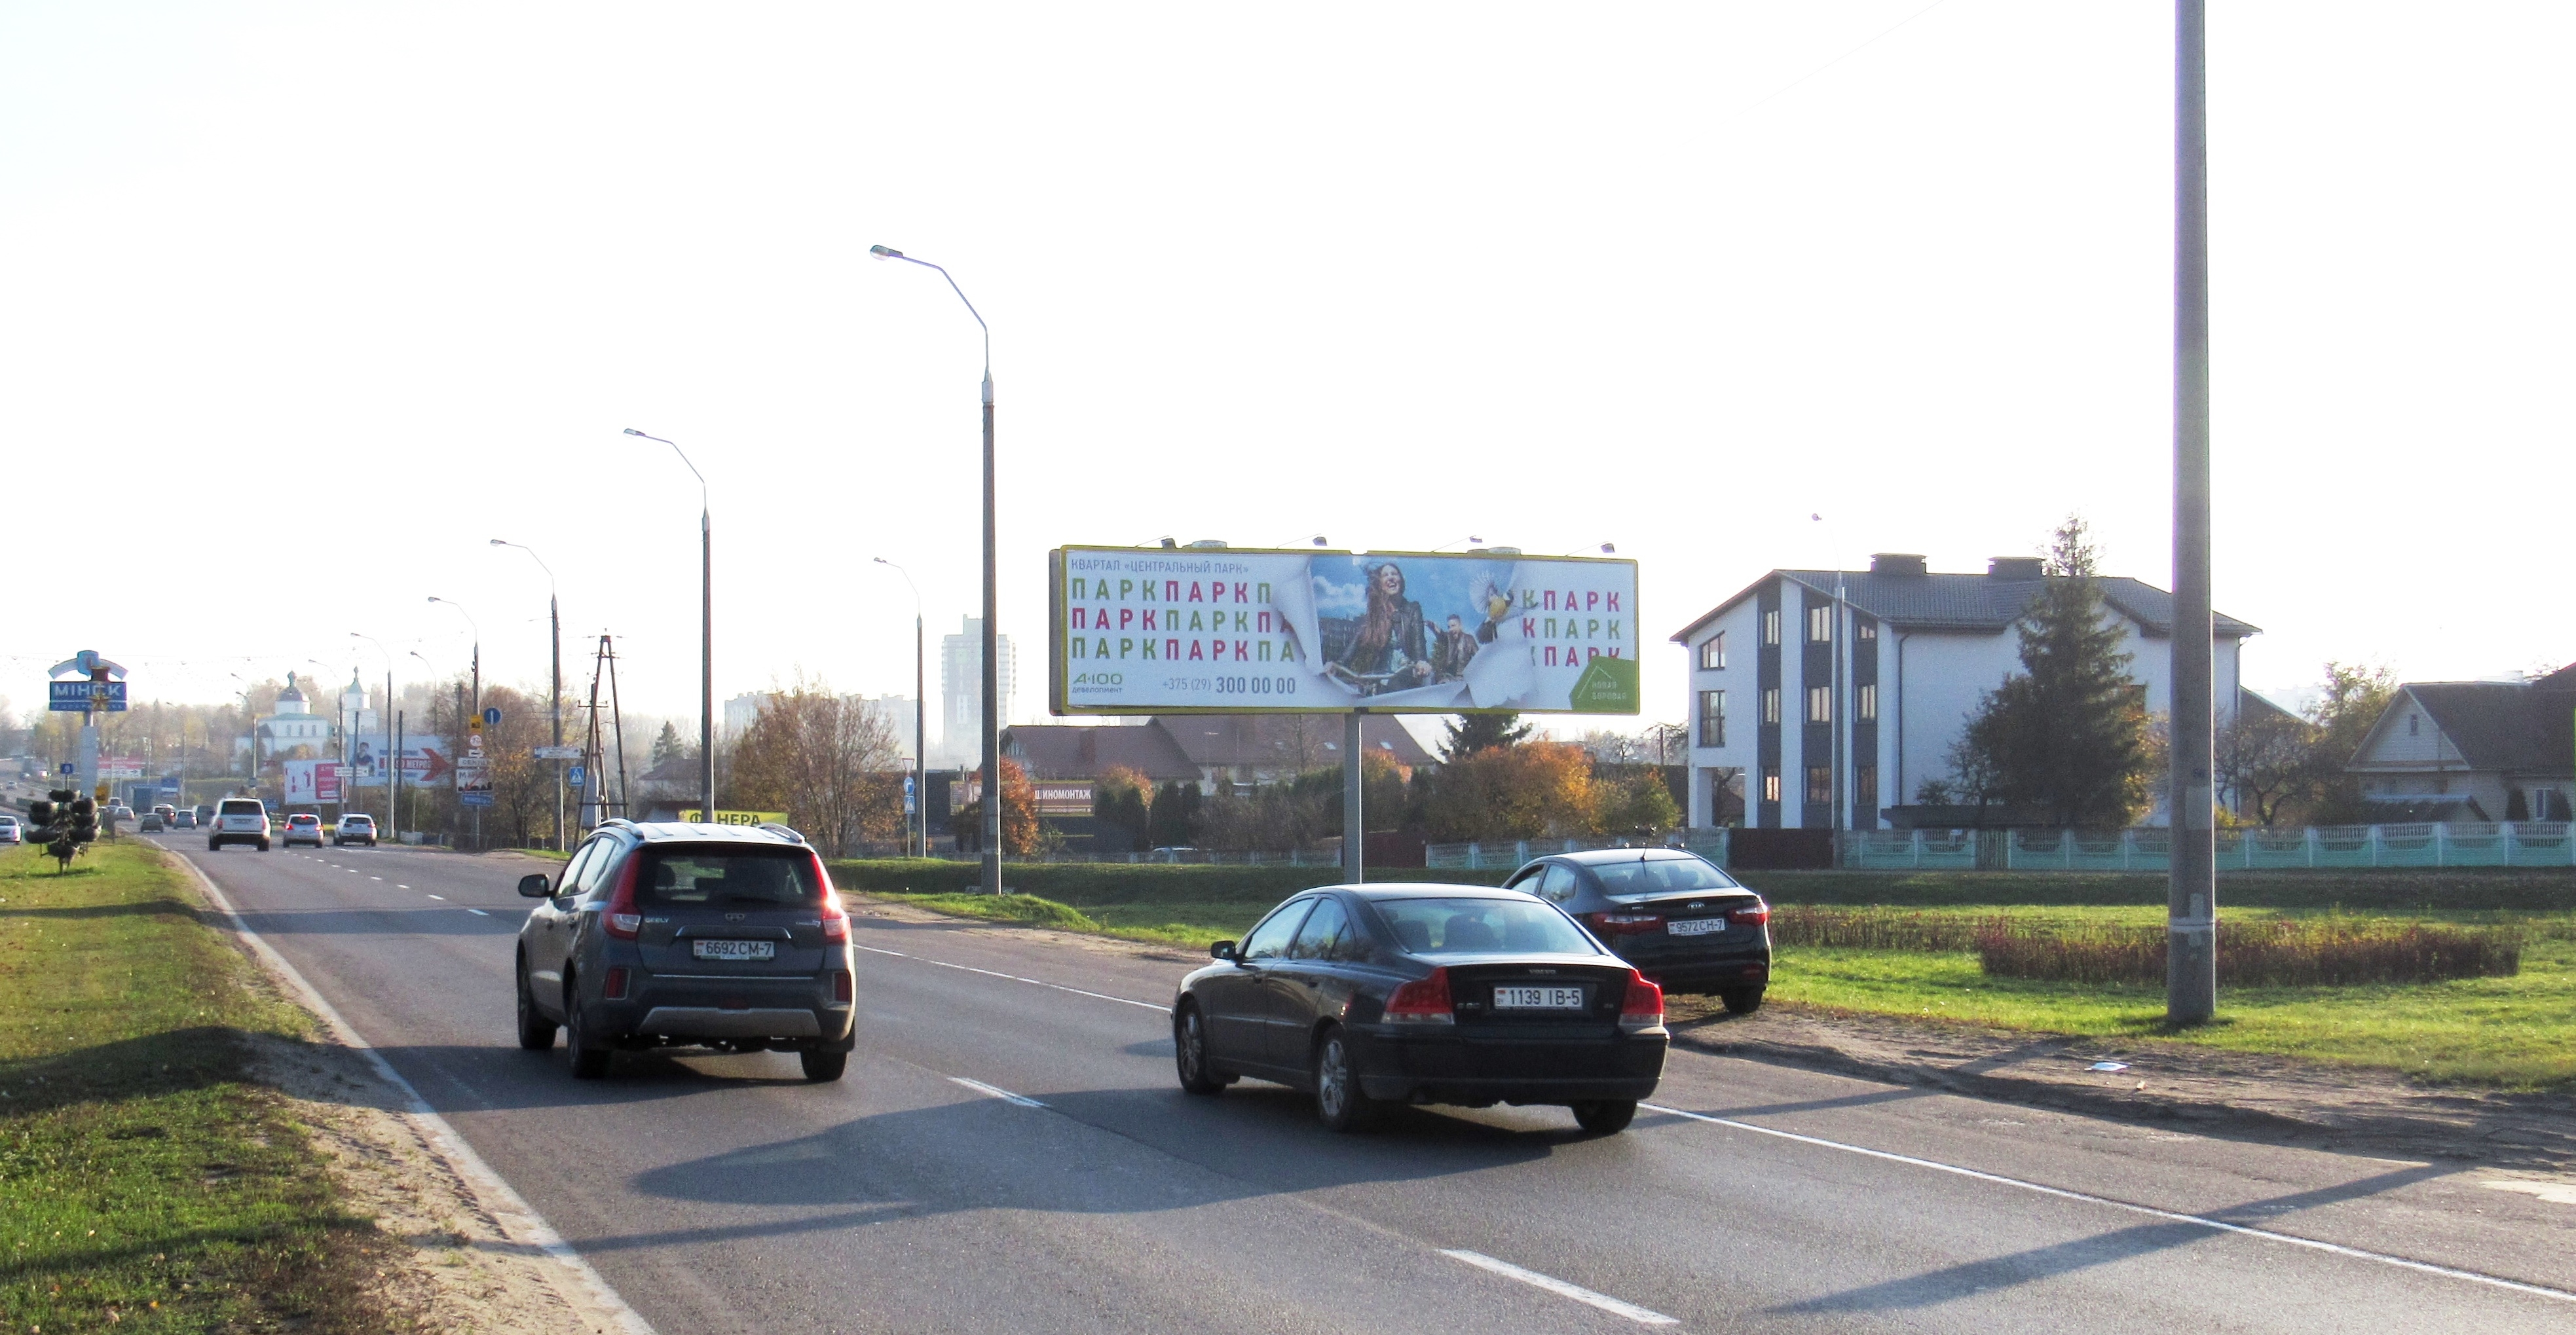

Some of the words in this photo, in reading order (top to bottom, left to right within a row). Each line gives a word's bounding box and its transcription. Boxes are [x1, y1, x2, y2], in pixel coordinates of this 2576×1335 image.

[1072, 559, 1120, 570] КВАРТАЛ
[1125, 560, 1210, 573] «ЦЕНТРАЛЬНЫЙ
[1214, 563, 1248, 574] ПАРК»
[1163, 678, 1187, 690] +375
[1191, 678, 1211, 691] (29)
[1216, 676, 1246, 693] 300
[1252, 677, 1270, 694] 00
[1277, 678, 1296, 694] 00
[1035, 789, 1092, 800] ШИНОМОНТАЖ
[690, 813, 761, 826] ФНЕРА
[1676, 922, 1698, 932] 9572
[706, 942, 736, 955] 6692
[739, 943, 772, 955] CM-7
[1510, 990, 1540, 1005] 1139
[1549, 990, 1580, 1005] IB-5
